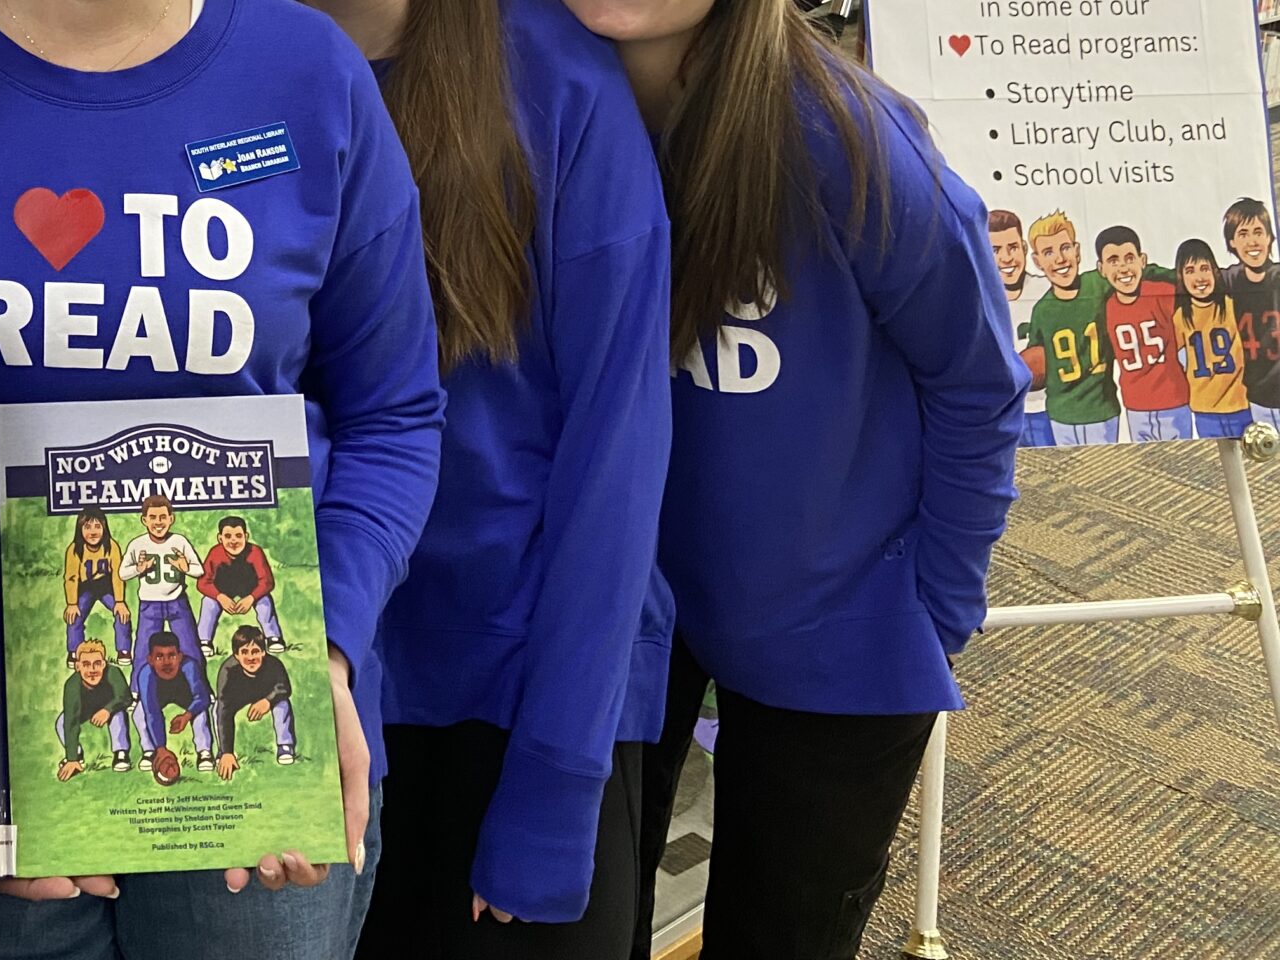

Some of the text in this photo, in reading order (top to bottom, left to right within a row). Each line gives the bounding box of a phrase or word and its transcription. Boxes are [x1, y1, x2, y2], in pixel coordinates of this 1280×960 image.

[938, 33, 1199, 60] I To Read programs:
[1006, 80, 1134, 109] Storytime
[1011, 117, 1227, 150] Library Club, and
[1014, 159, 1175, 187] School visits
[123, 193, 254, 281] TO
[1052, 321, 1107, 383] 91
[1114, 320, 1166, 372] 95
[56, 435, 263, 475] NOT WITHOUT MY
[55, 474, 267, 505] TEAMMATES
[109, 802, 262, 816] Written by Jeff McWhinney and Gwen Smid
[129, 813, 244, 825] Illustrations by Sheldon Dawson
[152, 841, 225, 851] Published by RSG.ca
